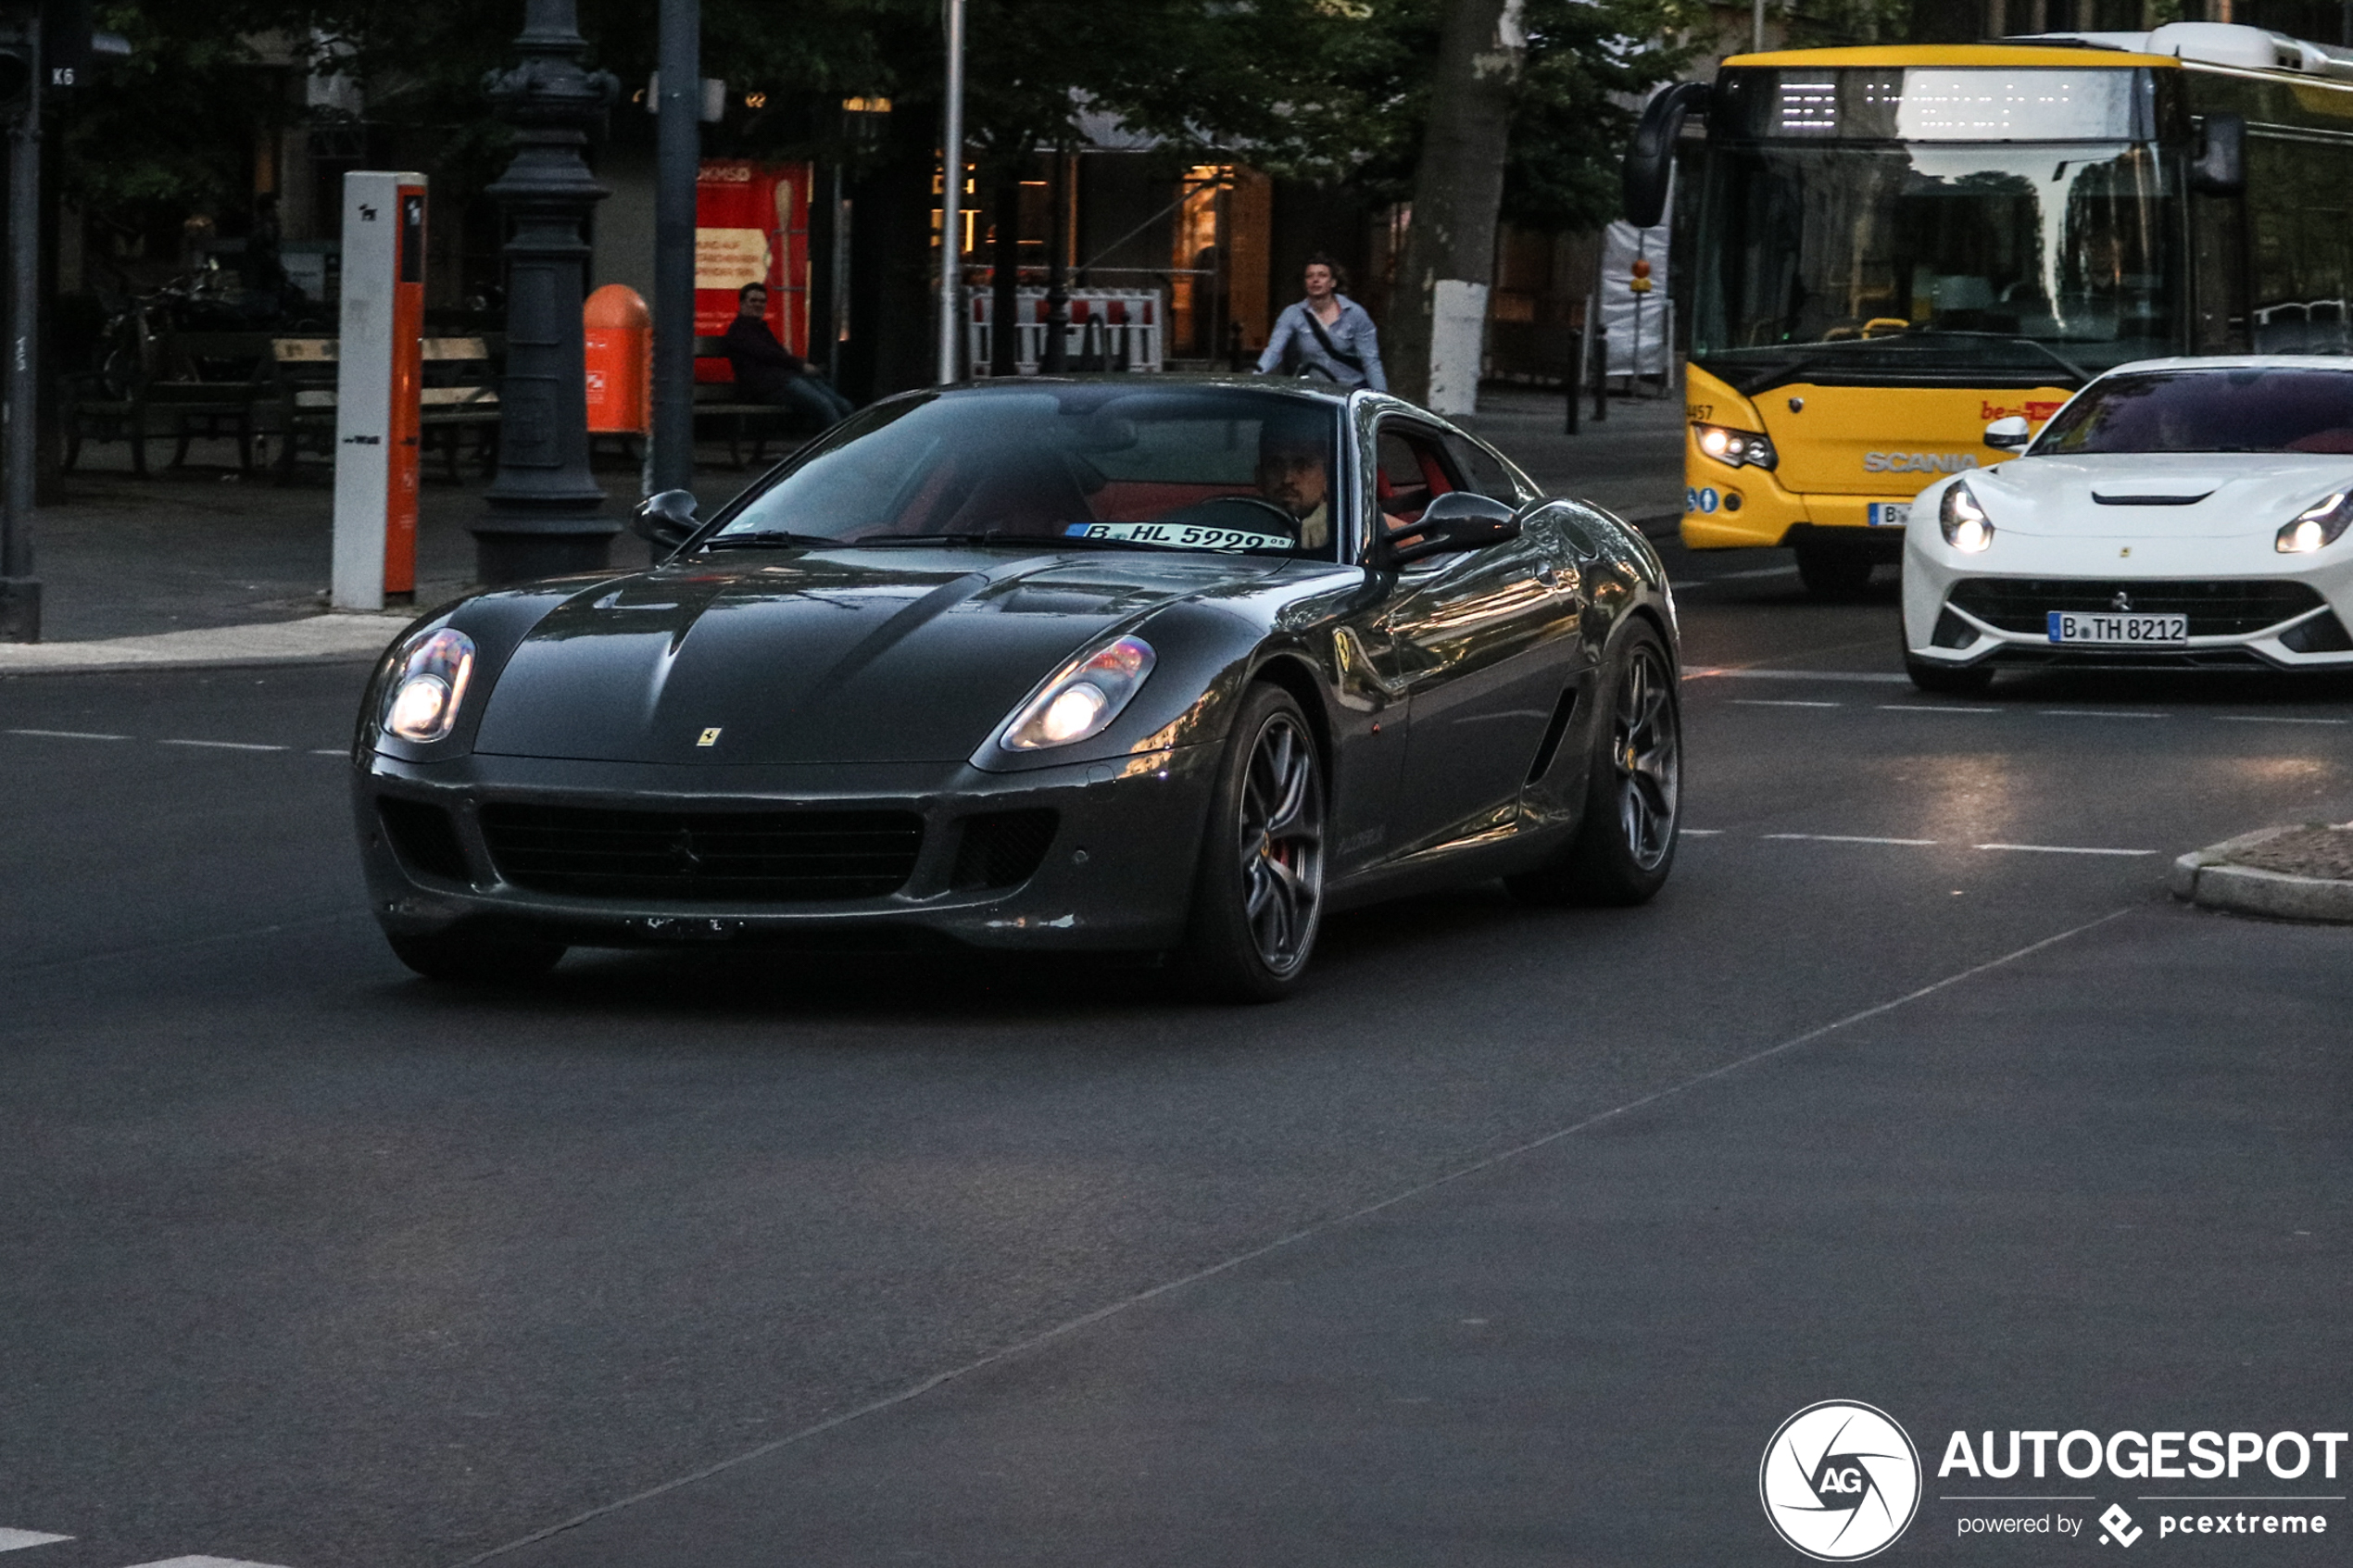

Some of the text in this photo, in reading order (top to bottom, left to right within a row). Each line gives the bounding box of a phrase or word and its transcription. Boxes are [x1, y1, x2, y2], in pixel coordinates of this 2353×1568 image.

[53, 68, 74, 85] K6
[1864, 452, 1979, 473] SCANIA
[1885, 506, 1896, 523] B
[1086, 525, 1109, 540] B
[1129, 525, 1171, 542] HL
[2063, 618, 2183, 641] B TH 8212
